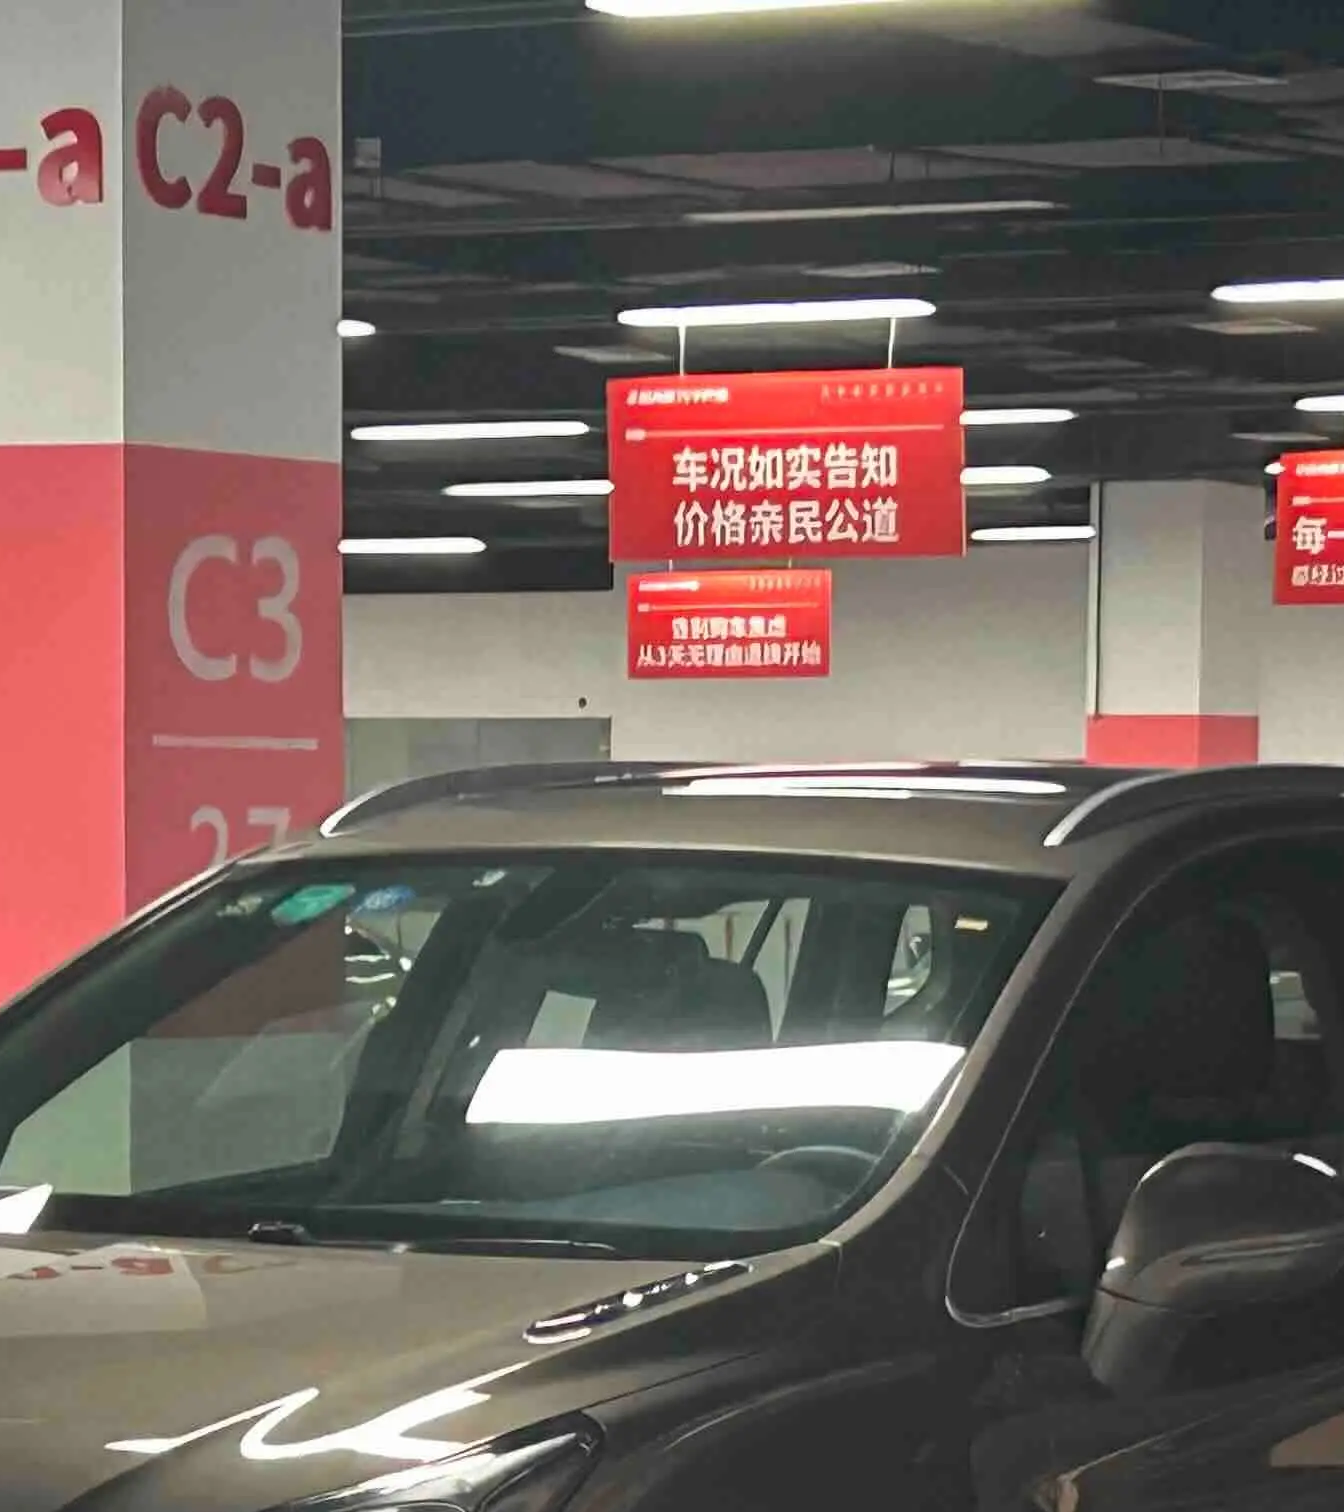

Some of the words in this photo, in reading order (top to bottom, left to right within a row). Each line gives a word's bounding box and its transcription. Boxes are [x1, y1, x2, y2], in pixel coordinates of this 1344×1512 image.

[135, 83, 335, 232] C2-a
[671, 442, 899, 493] 车况如实告知
[673, 496, 900, 547] 价格亲民公道
[167, 533, 305, 684] C3
